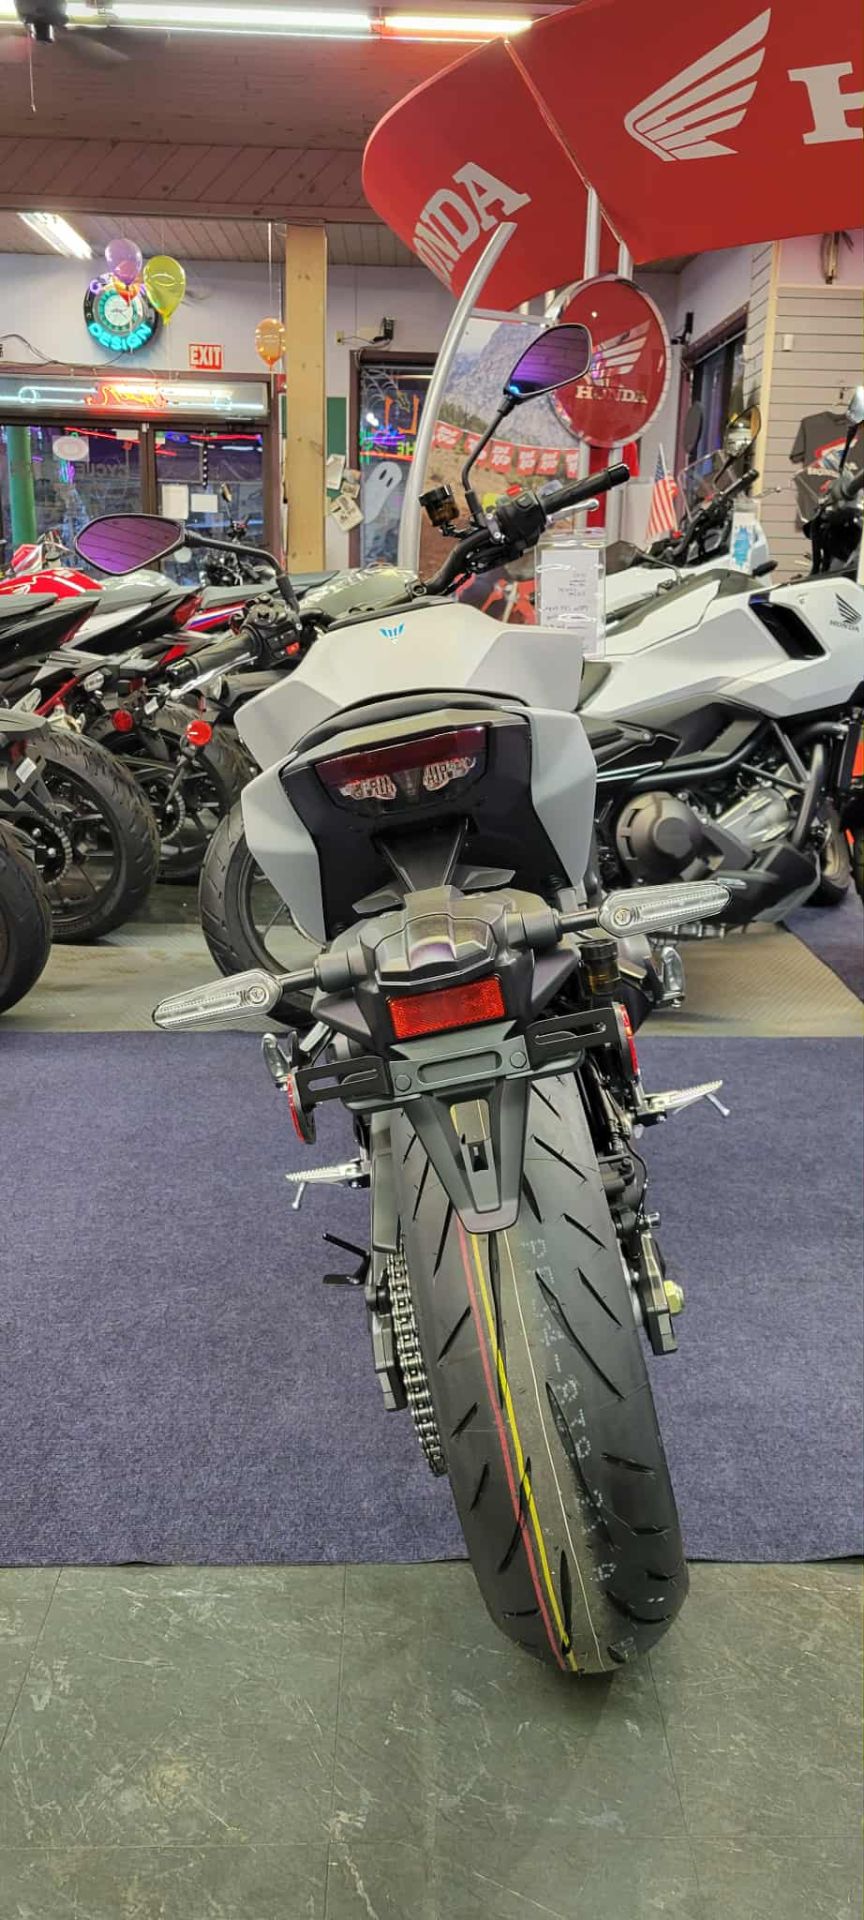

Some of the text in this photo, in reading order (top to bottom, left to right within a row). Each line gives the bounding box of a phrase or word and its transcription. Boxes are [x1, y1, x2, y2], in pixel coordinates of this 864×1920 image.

[412, 161, 532, 290] ONDA
[88, 322, 152, 351] DESIGN
[190, 346, 222, 365] EXIT
[575, 385, 648, 404] HONDA
